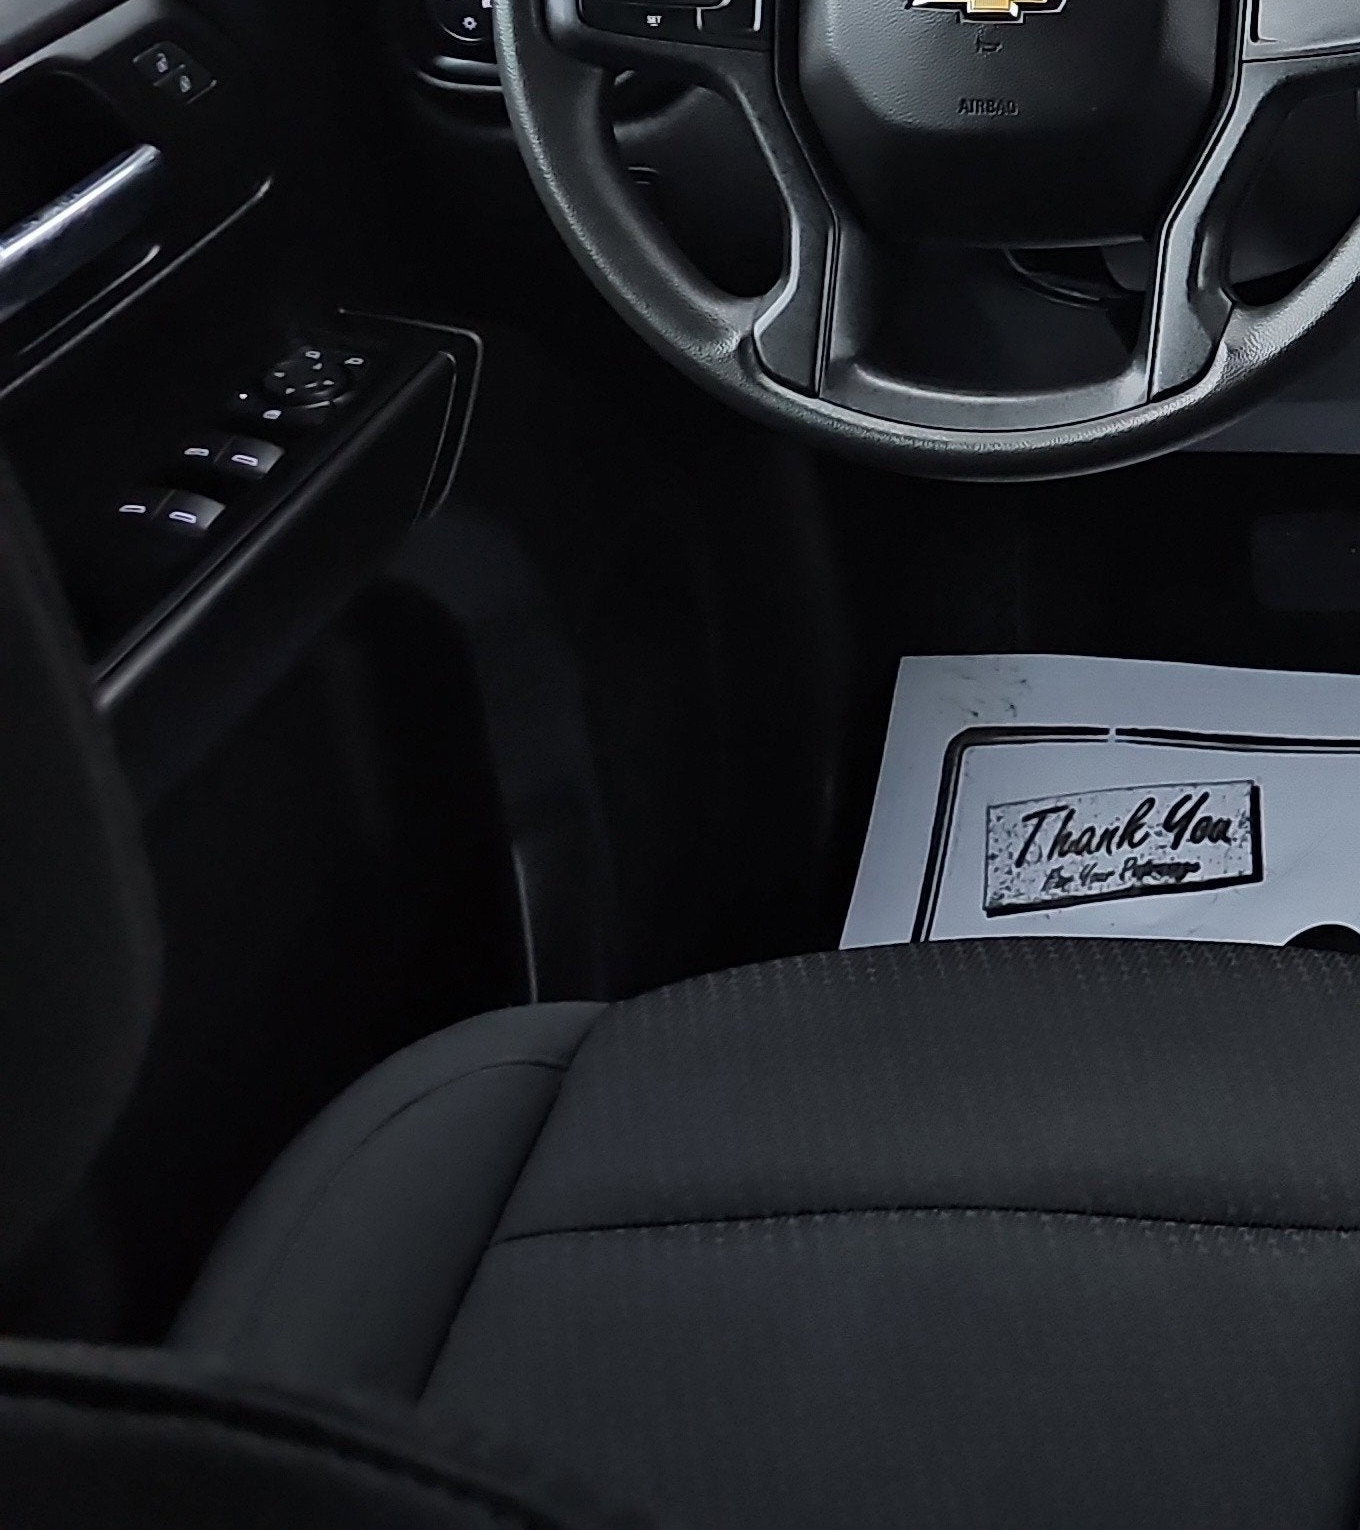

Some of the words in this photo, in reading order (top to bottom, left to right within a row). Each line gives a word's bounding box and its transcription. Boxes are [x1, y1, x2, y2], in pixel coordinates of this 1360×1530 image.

[957, 97, 1019, 117] AIRBAG
[1014, 796, 1157, 870] Thank
[1162, 791, 1233, 851] You
